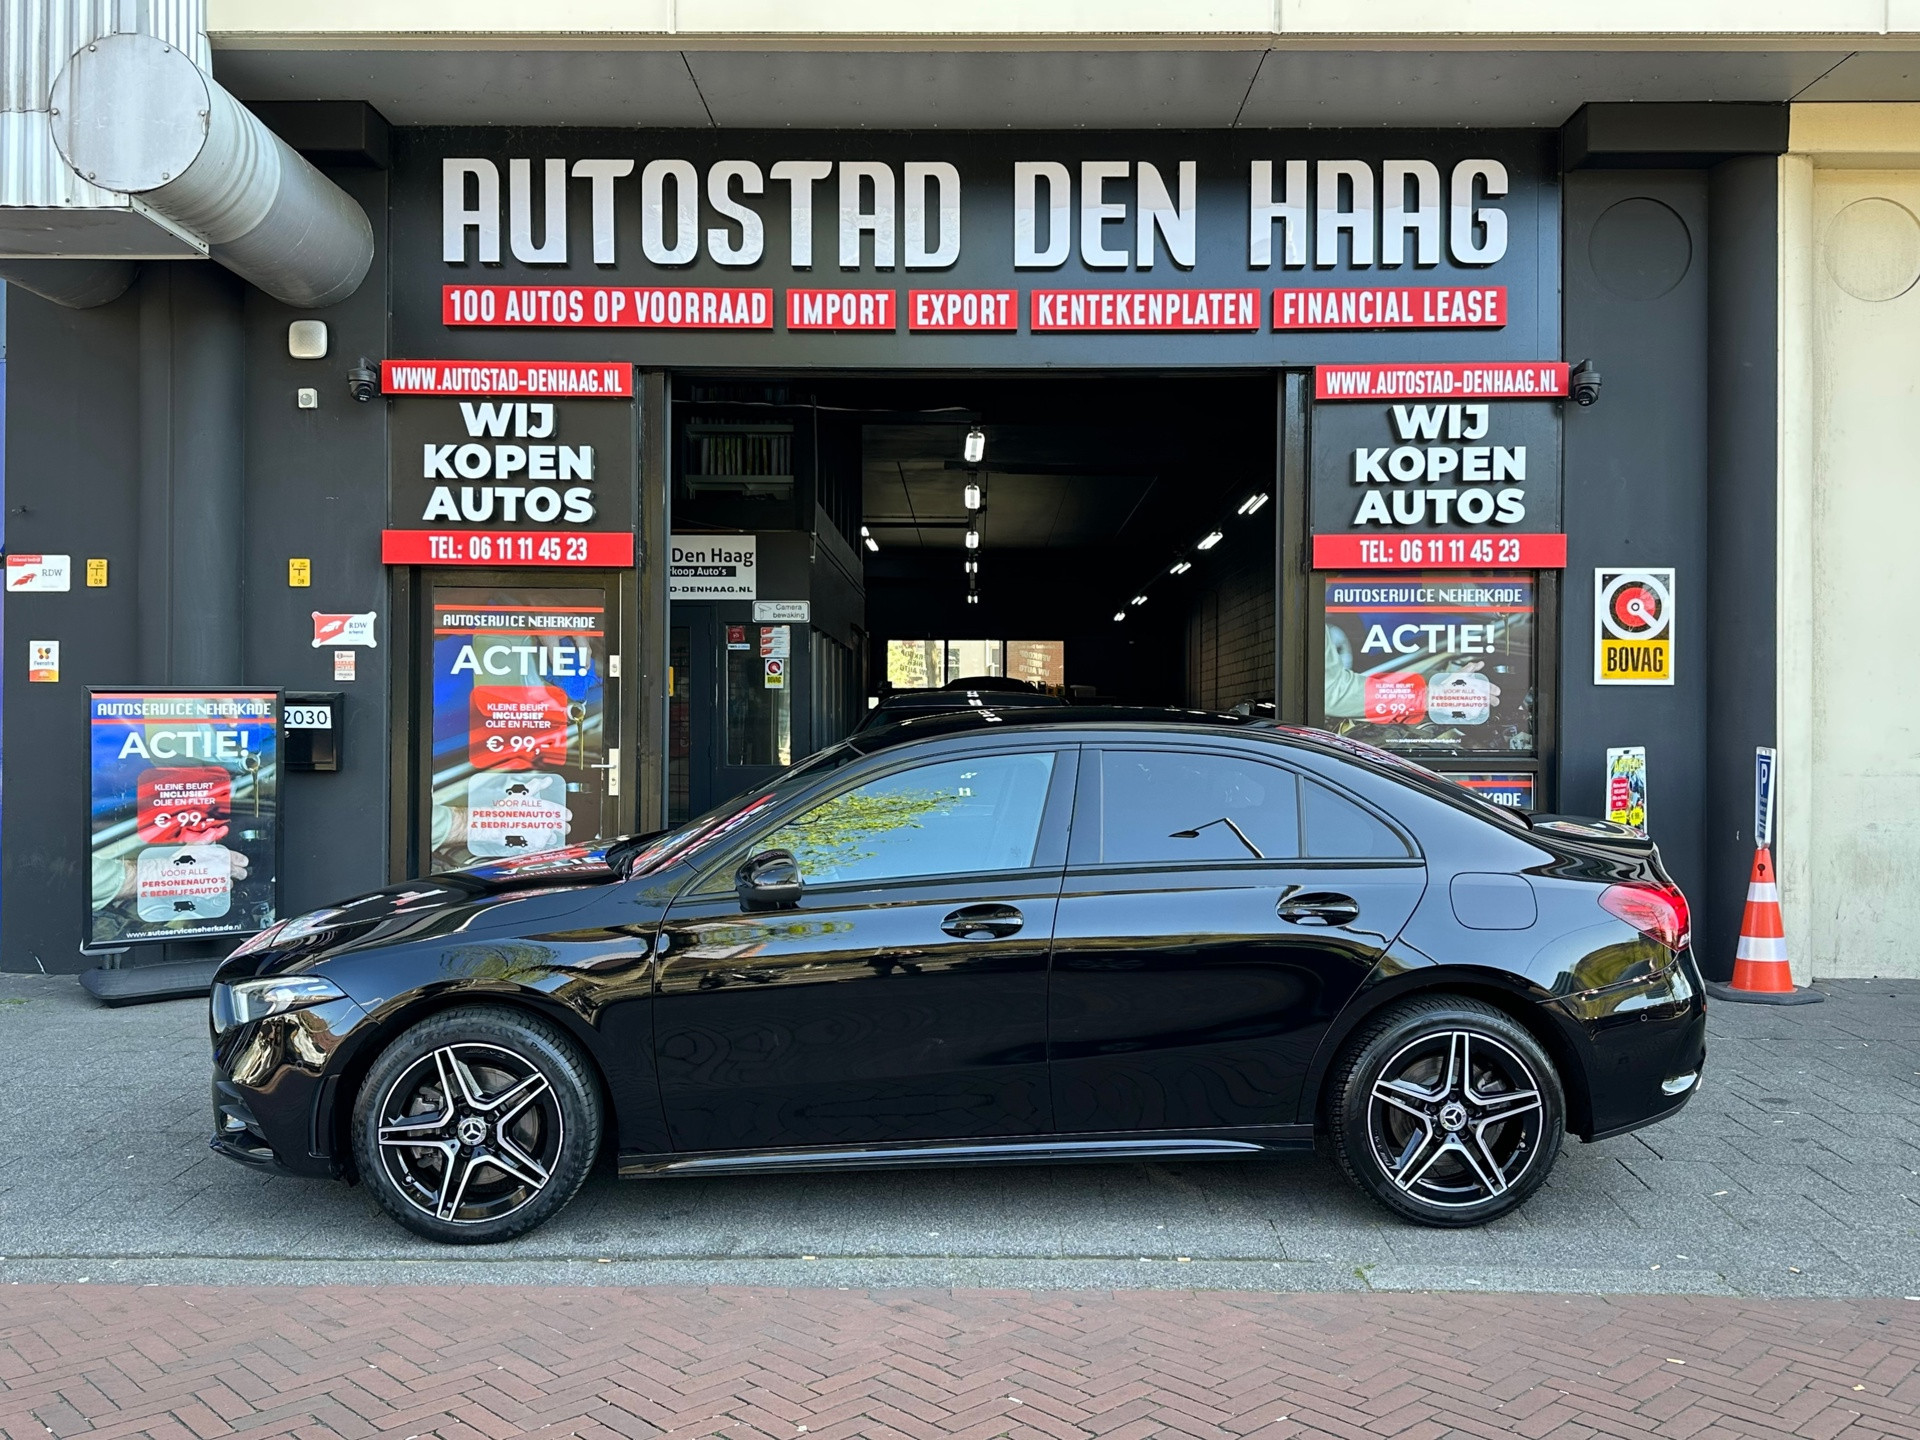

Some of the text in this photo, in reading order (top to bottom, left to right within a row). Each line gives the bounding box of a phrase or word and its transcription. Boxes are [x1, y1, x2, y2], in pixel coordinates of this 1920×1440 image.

[443, 158, 1509, 268] AUTOSTAD DEN HAAG
[450, 289, 767, 325] 100 AUTOS OP VOORRAAD
[793, 293, 889, 326] IMPORT
[916, 293, 1010, 327] EXPORT
[1038, 293, 1254, 326] KENTEKENPLATEN
[1283, 290, 1498, 325] FINANCIAL LEASE
[391, 367, 622, 392] WWW.AUTOSTAD-DENHAAG.NL
[1326, 369, 1559, 394] WWW.AUTOSTAD-DENHAAG.NL
[459, 402, 554, 438] WIJ
[1392, 404, 1489, 439] WIJ
[423, 443, 593, 480] KOPEN
[1355, 446, 1526, 482] KOPEN
[422, 486, 594, 523] AUTOS
[1354, 488, 1526, 524] AUTOS
[429, 536, 588, 561] TEL: 06 11 11 45 23
[672, 548, 754, 567] Den Haag
[1360, 539, 1520, 562] TEL: 06 11 11 45 23
[42, 569, 63, 577] RDW
[670, 567, 727, 577] koop Auto's
[1334, 588, 1522, 603] AUTOSERVICE NEHERKADE
[443, 614, 595, 628] AUTOSERVICE NEHERKADE
[1361, 624, 1495, 654] ACTIE!
[450, 645, 588, 676] ACTIE!
[1607, 647, 1664, 672] BOVAG
[97, 703, 271, 716] AUTOSERVICE NEHERKADE
[284, 710, 327, 725] 2030
[492, 712, 544, 720] INCLUSIEF
[1376, 704, 1387, 714] €
[118, 731, 249, 759] ACTIE!
[486, 736, 550, 754] € 99,-
[154, 782, 214, 791] KLEINE BEURT
[160, 791, 209, 799] INCLUSIEF
[153, 798, 216, 807] OLIE EN FILTER
[154, 812, 215, 829] € 99,-
[142, 877, 226, 888] PERSONENAUTO'S
[161, 868, 208, 877] VOOR ALLE
[150, 886, 227, 897] BEDRIJFSAUTO'S
[126, 924, 242, 938] www.autoserviceneherkade.nl
